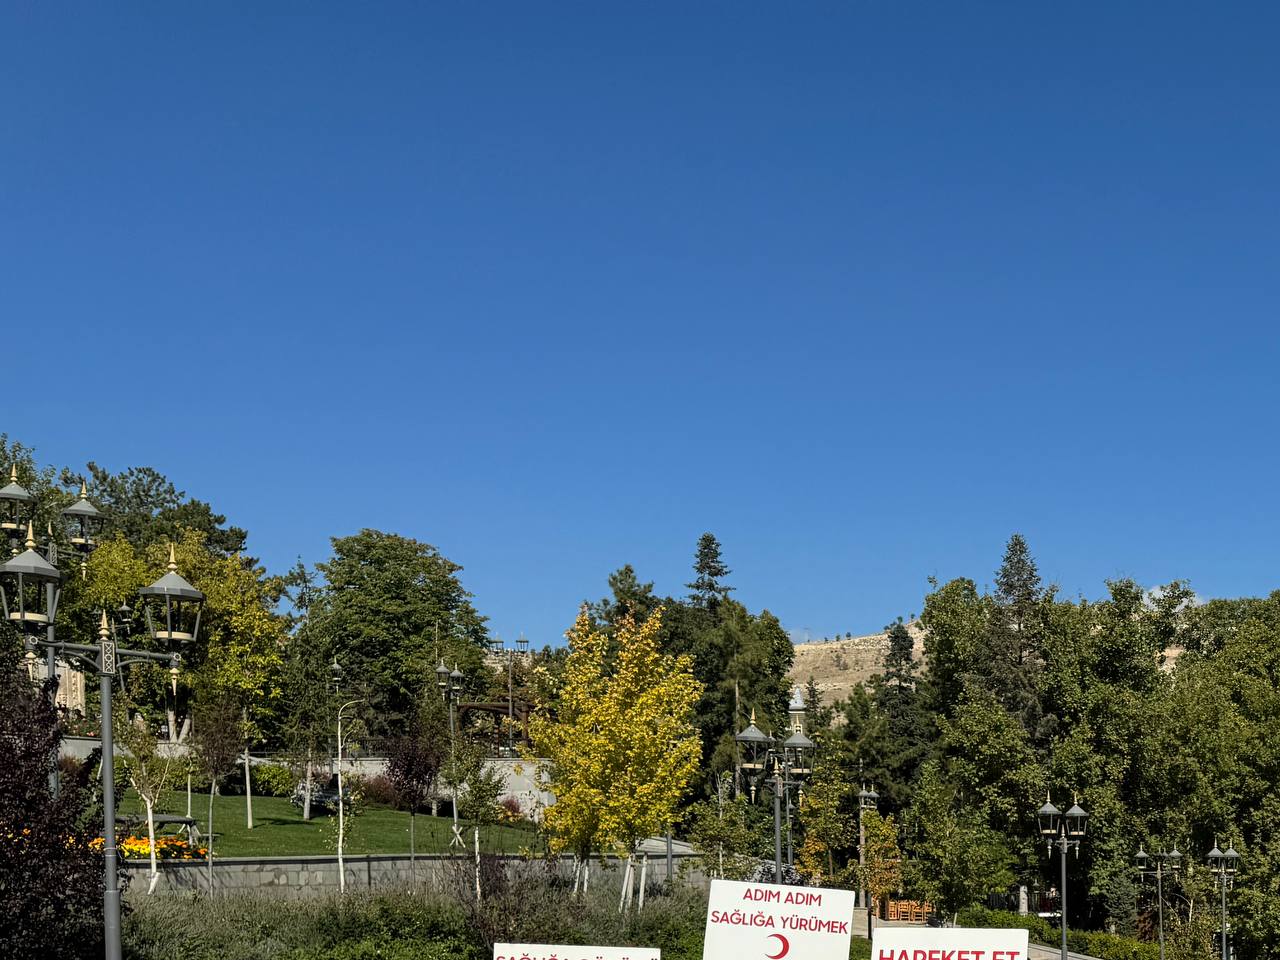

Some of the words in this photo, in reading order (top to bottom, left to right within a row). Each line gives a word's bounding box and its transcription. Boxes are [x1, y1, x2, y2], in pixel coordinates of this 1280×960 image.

[743, 888, 780, 904] ADIM
[784, 891, 822, 907] ADIM
[710, 909, 775, 929] SAĞLIĞA
[780, 914, 849, 935] YÜRÜMEK
